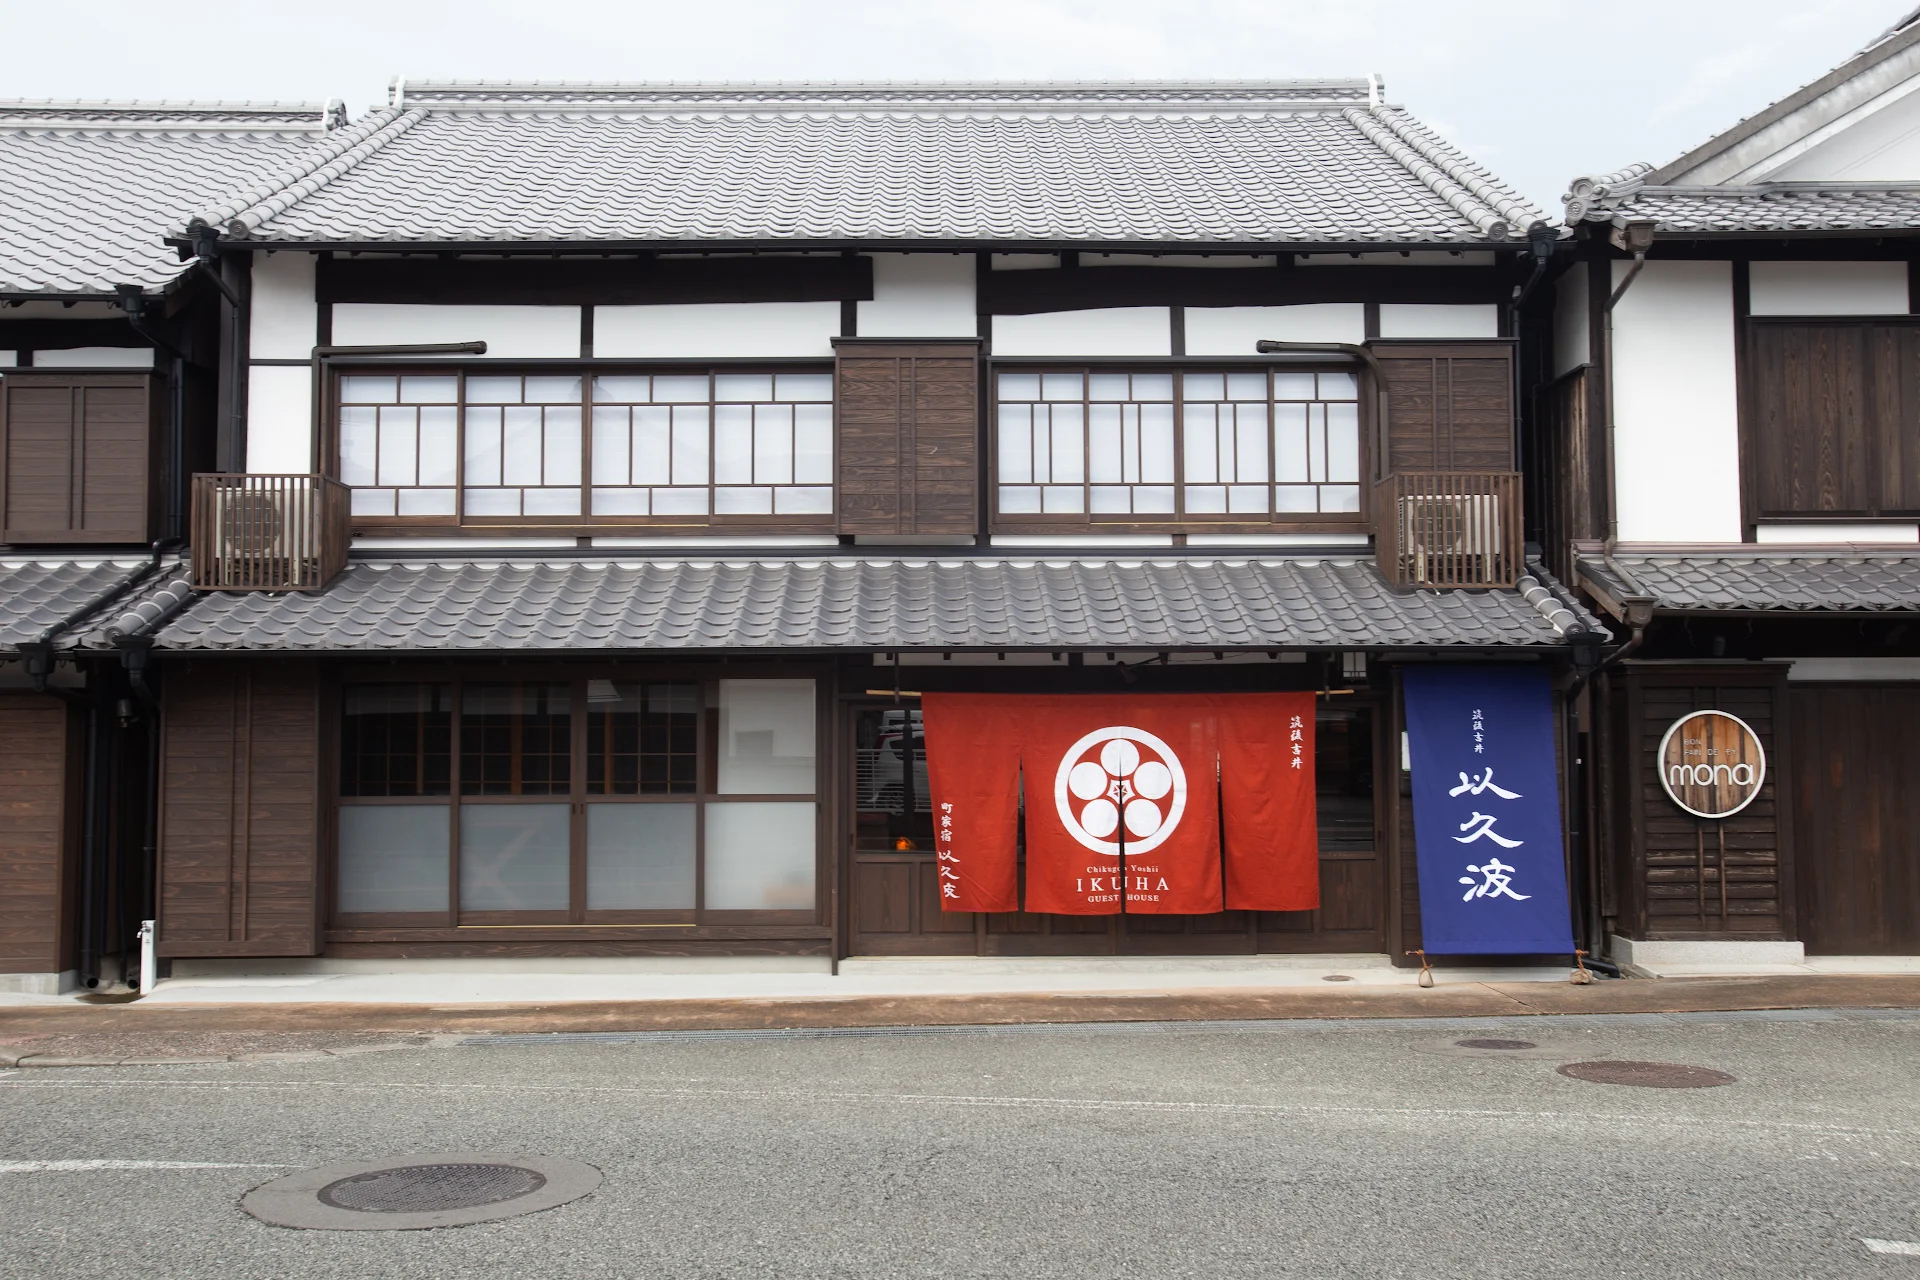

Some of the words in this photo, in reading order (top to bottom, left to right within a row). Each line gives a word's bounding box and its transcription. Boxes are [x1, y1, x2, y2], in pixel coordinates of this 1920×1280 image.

[1289, 715, 1304, 770] 筑後吉井
[1471, 709, 1485, 754] 筑後吉井
[1707, 748, 1719, 756] DE
[1670, 763, 1754, 786] mona
[940, 802, 953, 842] 町家宿
[1449, 767, 1533, 902] 以久波
[1130, 865, 1159, 873] Yoshii
[1076, 877, 1169, 892] IKUHA
[1087, 894, 1119, 903] GUEST
[1127, 894, 1159, 902] HOUSE
